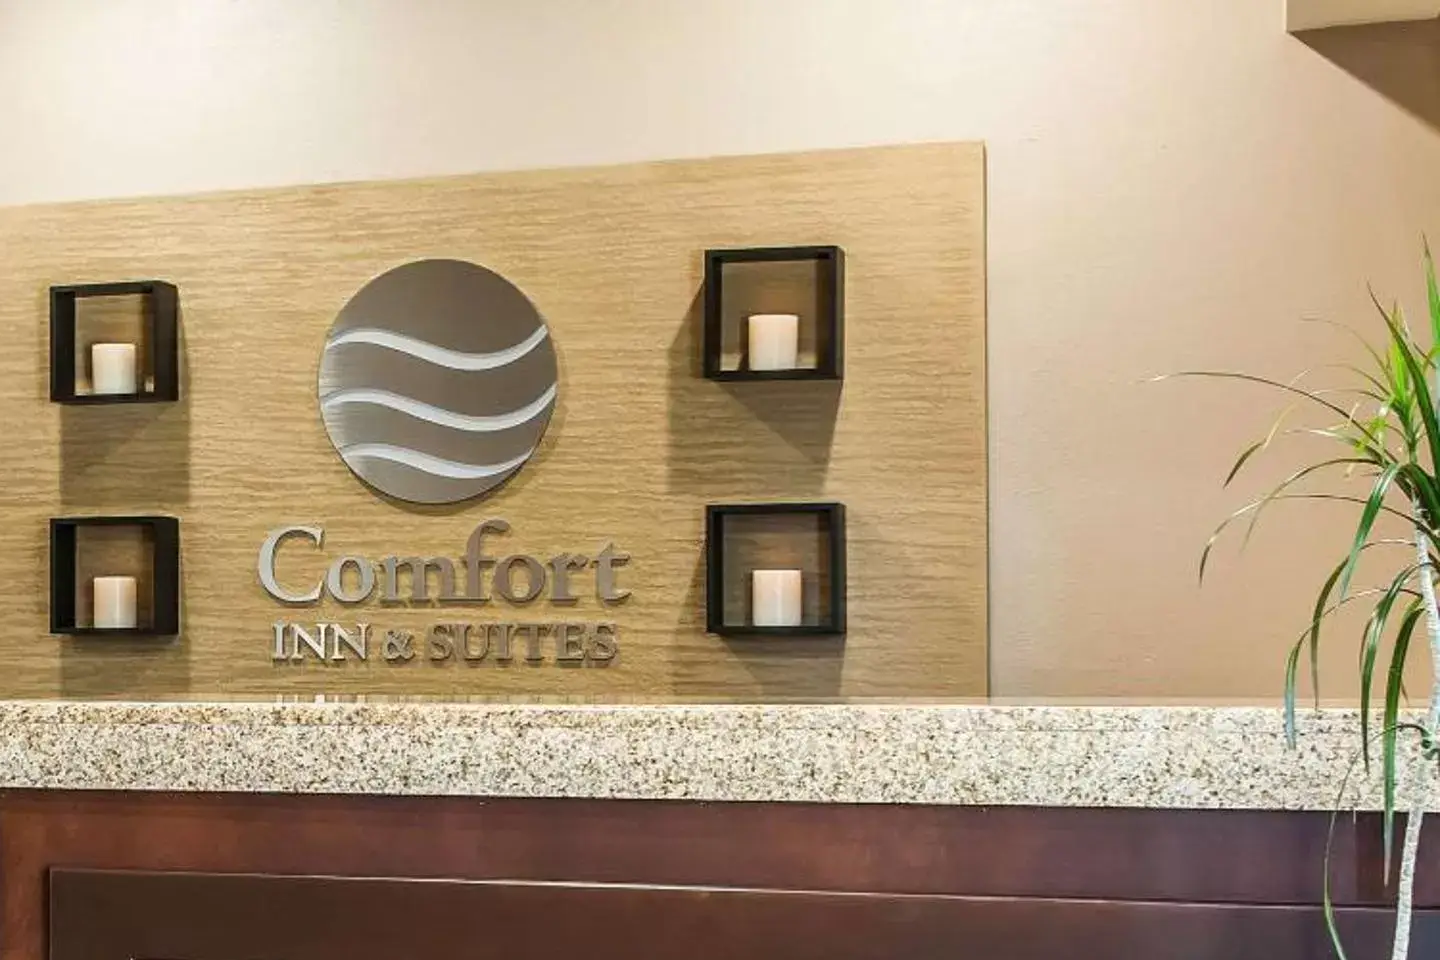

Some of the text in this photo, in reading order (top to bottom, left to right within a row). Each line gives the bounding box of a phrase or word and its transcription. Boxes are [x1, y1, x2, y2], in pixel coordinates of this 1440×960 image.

[258, 518, 633, 605] Comfort
[271, 621, 619, 664] INN & SUITES
